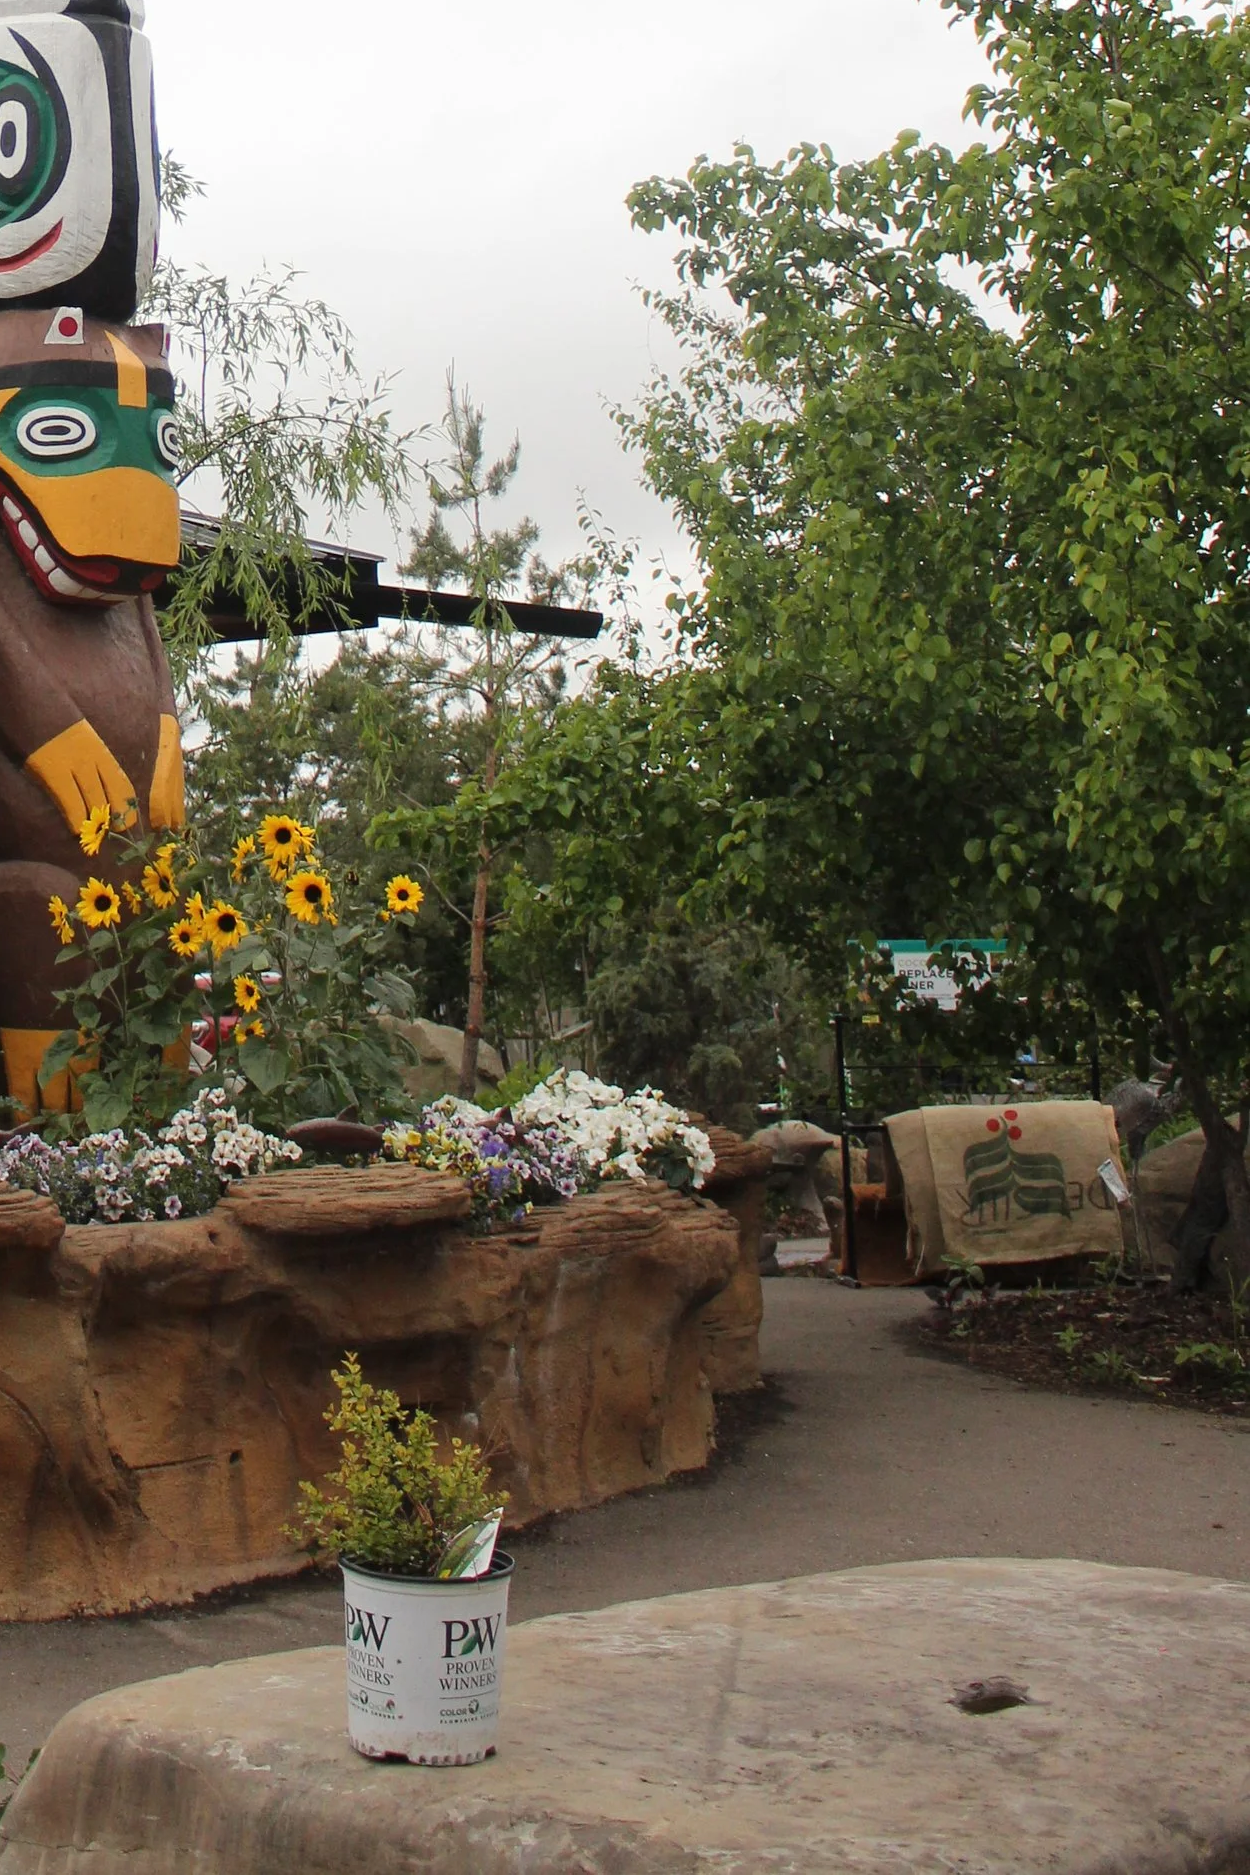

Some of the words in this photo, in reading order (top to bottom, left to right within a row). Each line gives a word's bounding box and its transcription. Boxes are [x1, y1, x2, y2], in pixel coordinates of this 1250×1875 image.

[899, 969, 953, 979] REPLACE
[908, 980, 935, 990] NER
[441, 1613, 502, 1659] PW
[446, 1656, 495, 1675] PROVEN
[439, 1672, 496, 1691] WINNERS
[440, 1708, 467, 1716] COLOR
